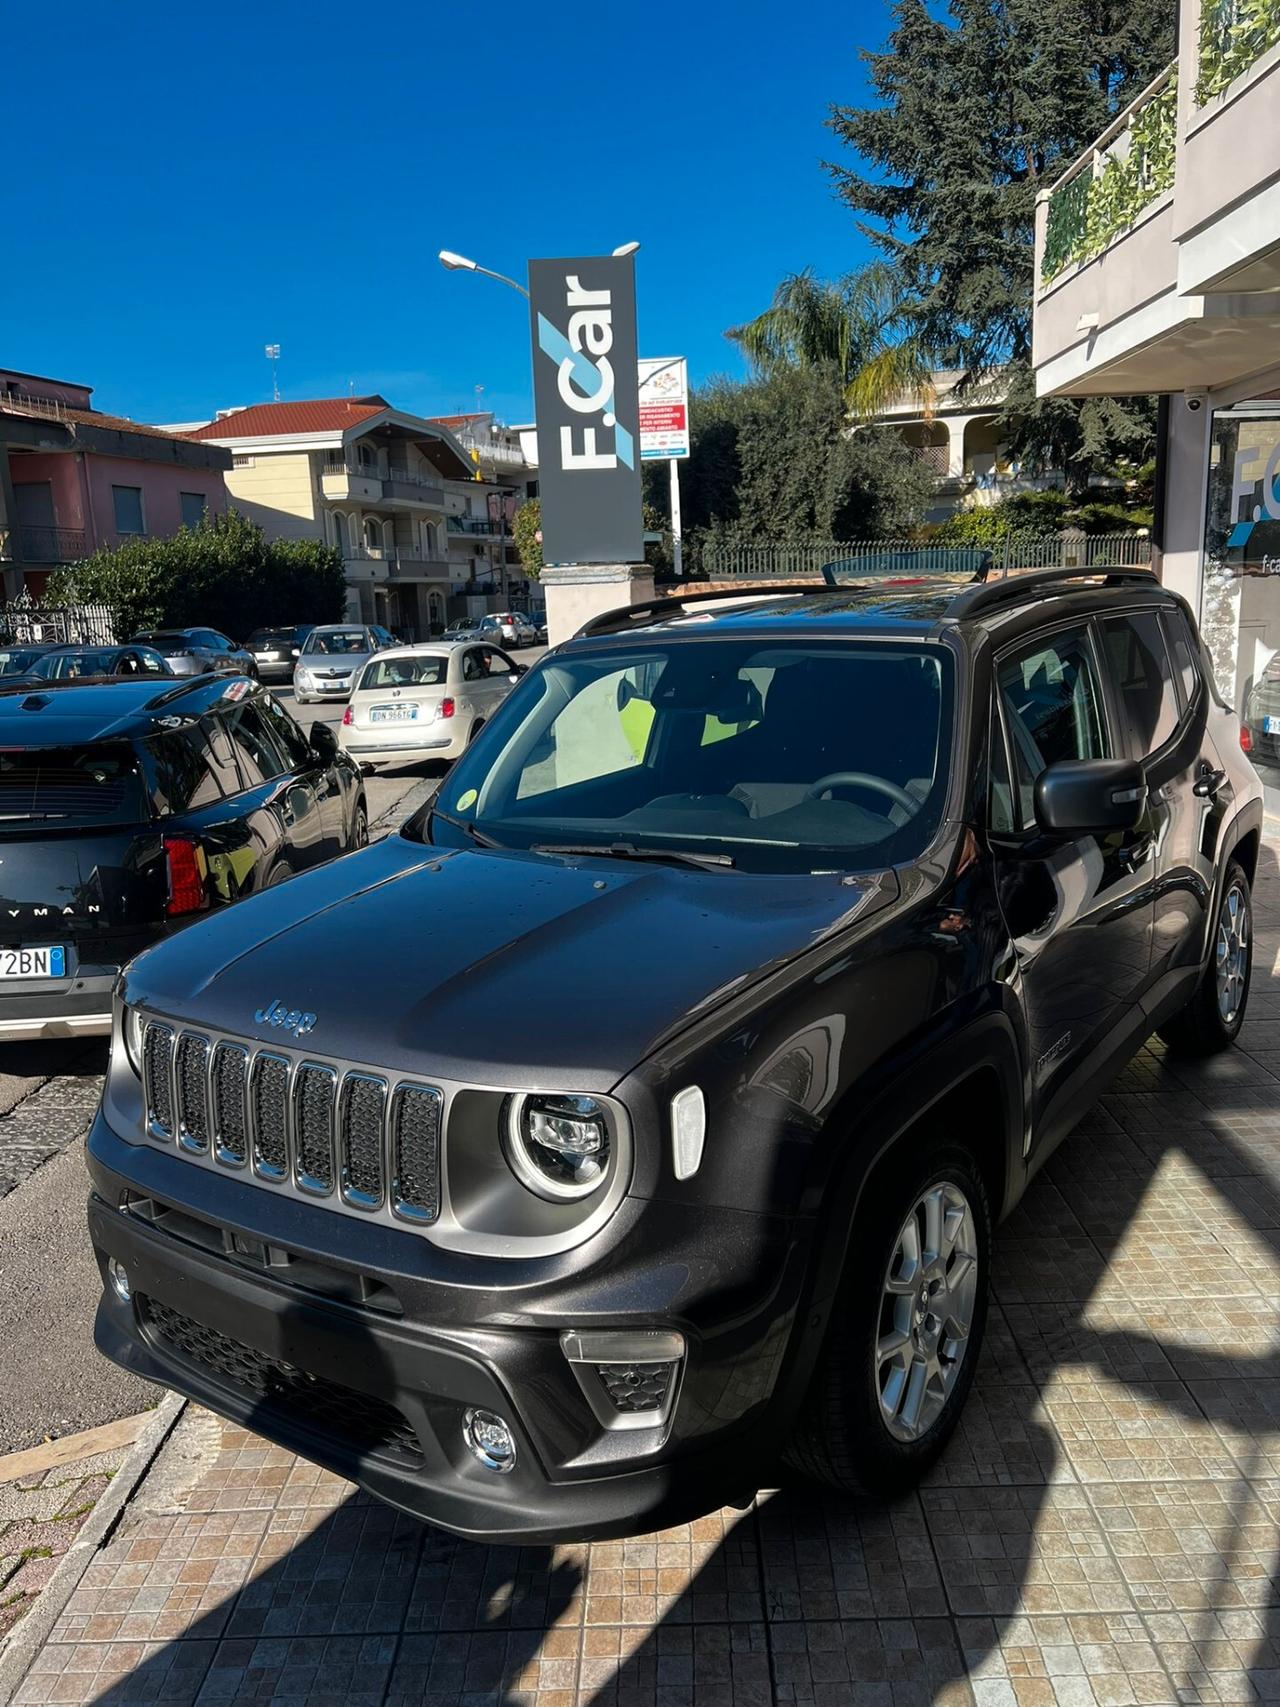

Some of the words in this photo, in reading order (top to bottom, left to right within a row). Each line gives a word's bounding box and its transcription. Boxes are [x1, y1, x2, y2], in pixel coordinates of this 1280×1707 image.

[557, 275, 618, 471] F.Car
[8, 905, 100, 918] YMAN
[0, 951, 47, 975] 2BN
[254, 999, 318, 1038] Jeep
